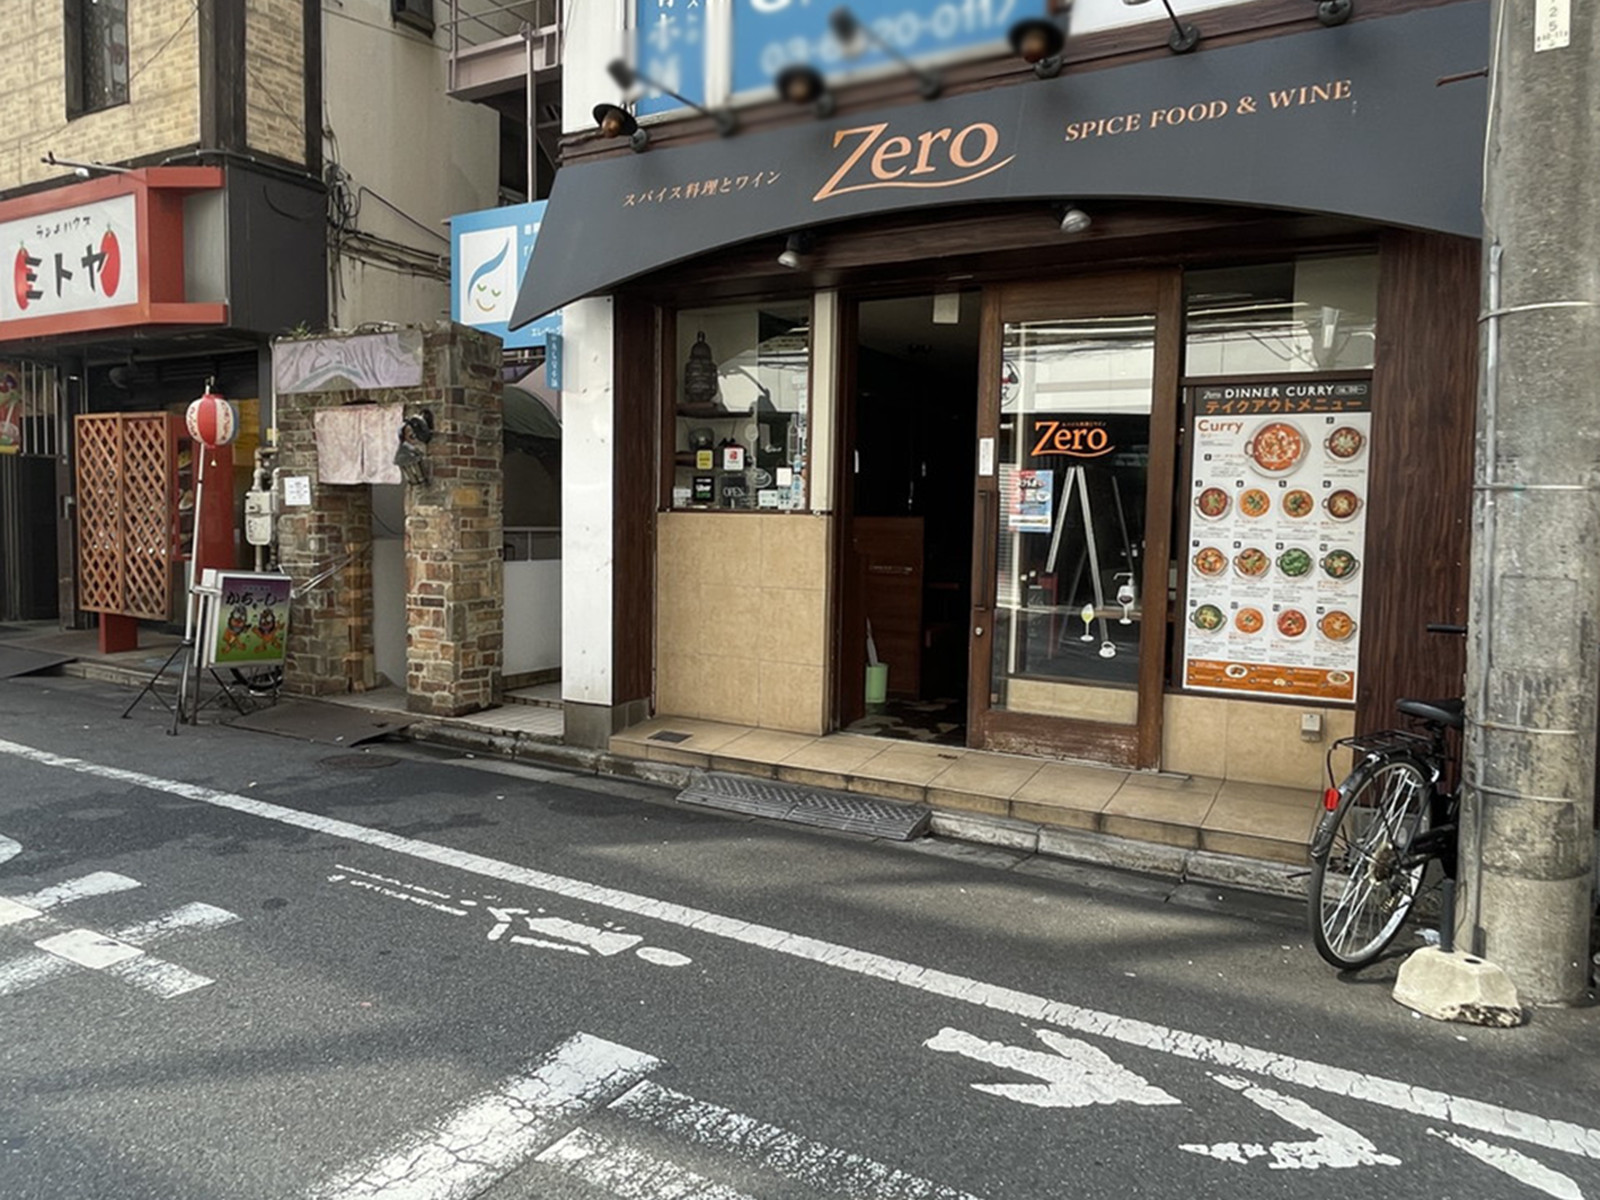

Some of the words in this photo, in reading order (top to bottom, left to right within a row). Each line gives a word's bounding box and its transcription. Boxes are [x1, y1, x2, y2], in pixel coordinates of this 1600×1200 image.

[1065, 113, 1141, 142] SPICE
[1149, 100, 1229, 128] FOOD
[1236, 96, 1257, 115] &
[1268, 80, 1352, 109] WINE
[812, 122, 1016, 202] Zero
[622, 171, 782, 207] スパイス料理とワイン
[24, 243, 109, 300] ミトヤ
[1206, 398, 1362, 414] テイクアウトメニュー
[1225, 387, 1279, 398] DINNER
[1286, 385, 1335, 397] CURRY
[1031, 421, 1115, 458] Zero
[1198, 420, 1243, 434] Curry
